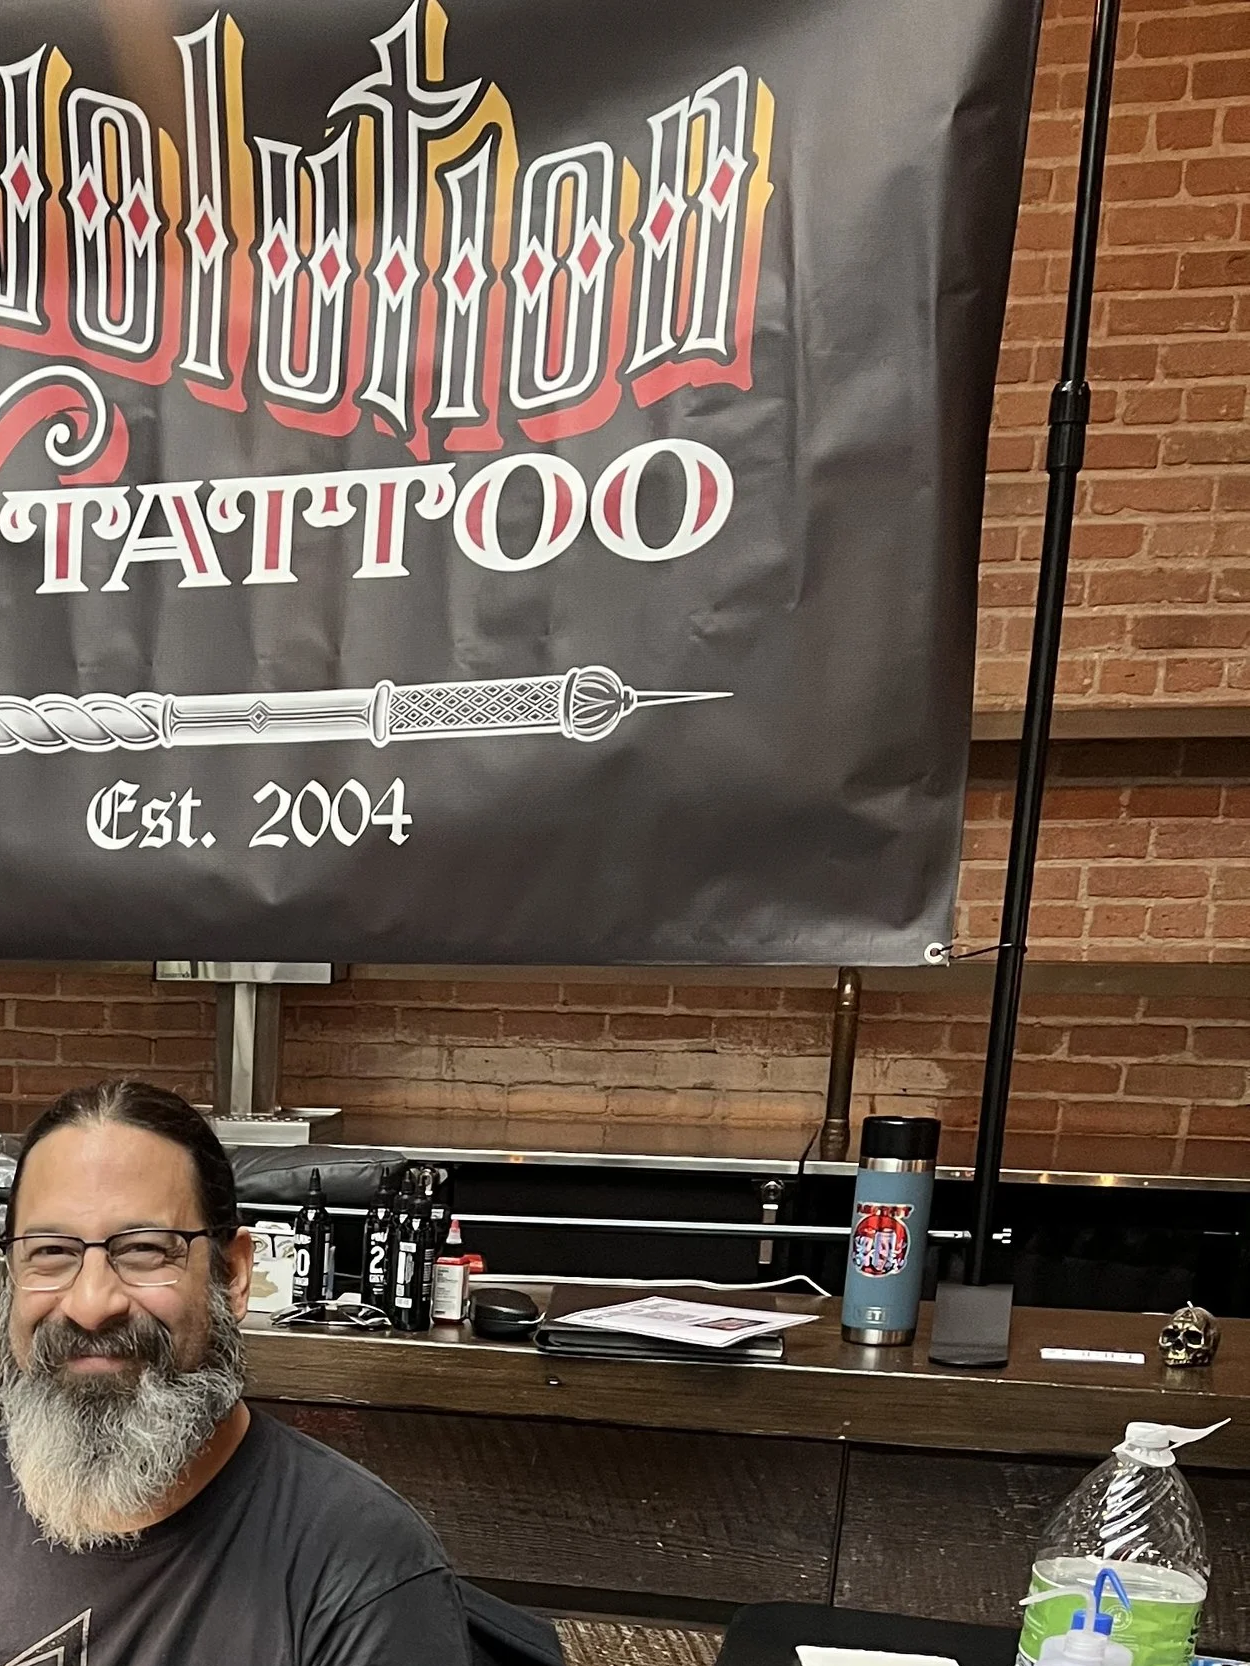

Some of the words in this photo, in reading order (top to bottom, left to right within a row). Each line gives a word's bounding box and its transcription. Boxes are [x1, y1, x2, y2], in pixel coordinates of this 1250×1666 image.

[0, 437, 735, 594] TATTOO
[86, 779, 217, 850] Est.
[248, 777, 413, 846] 2004
